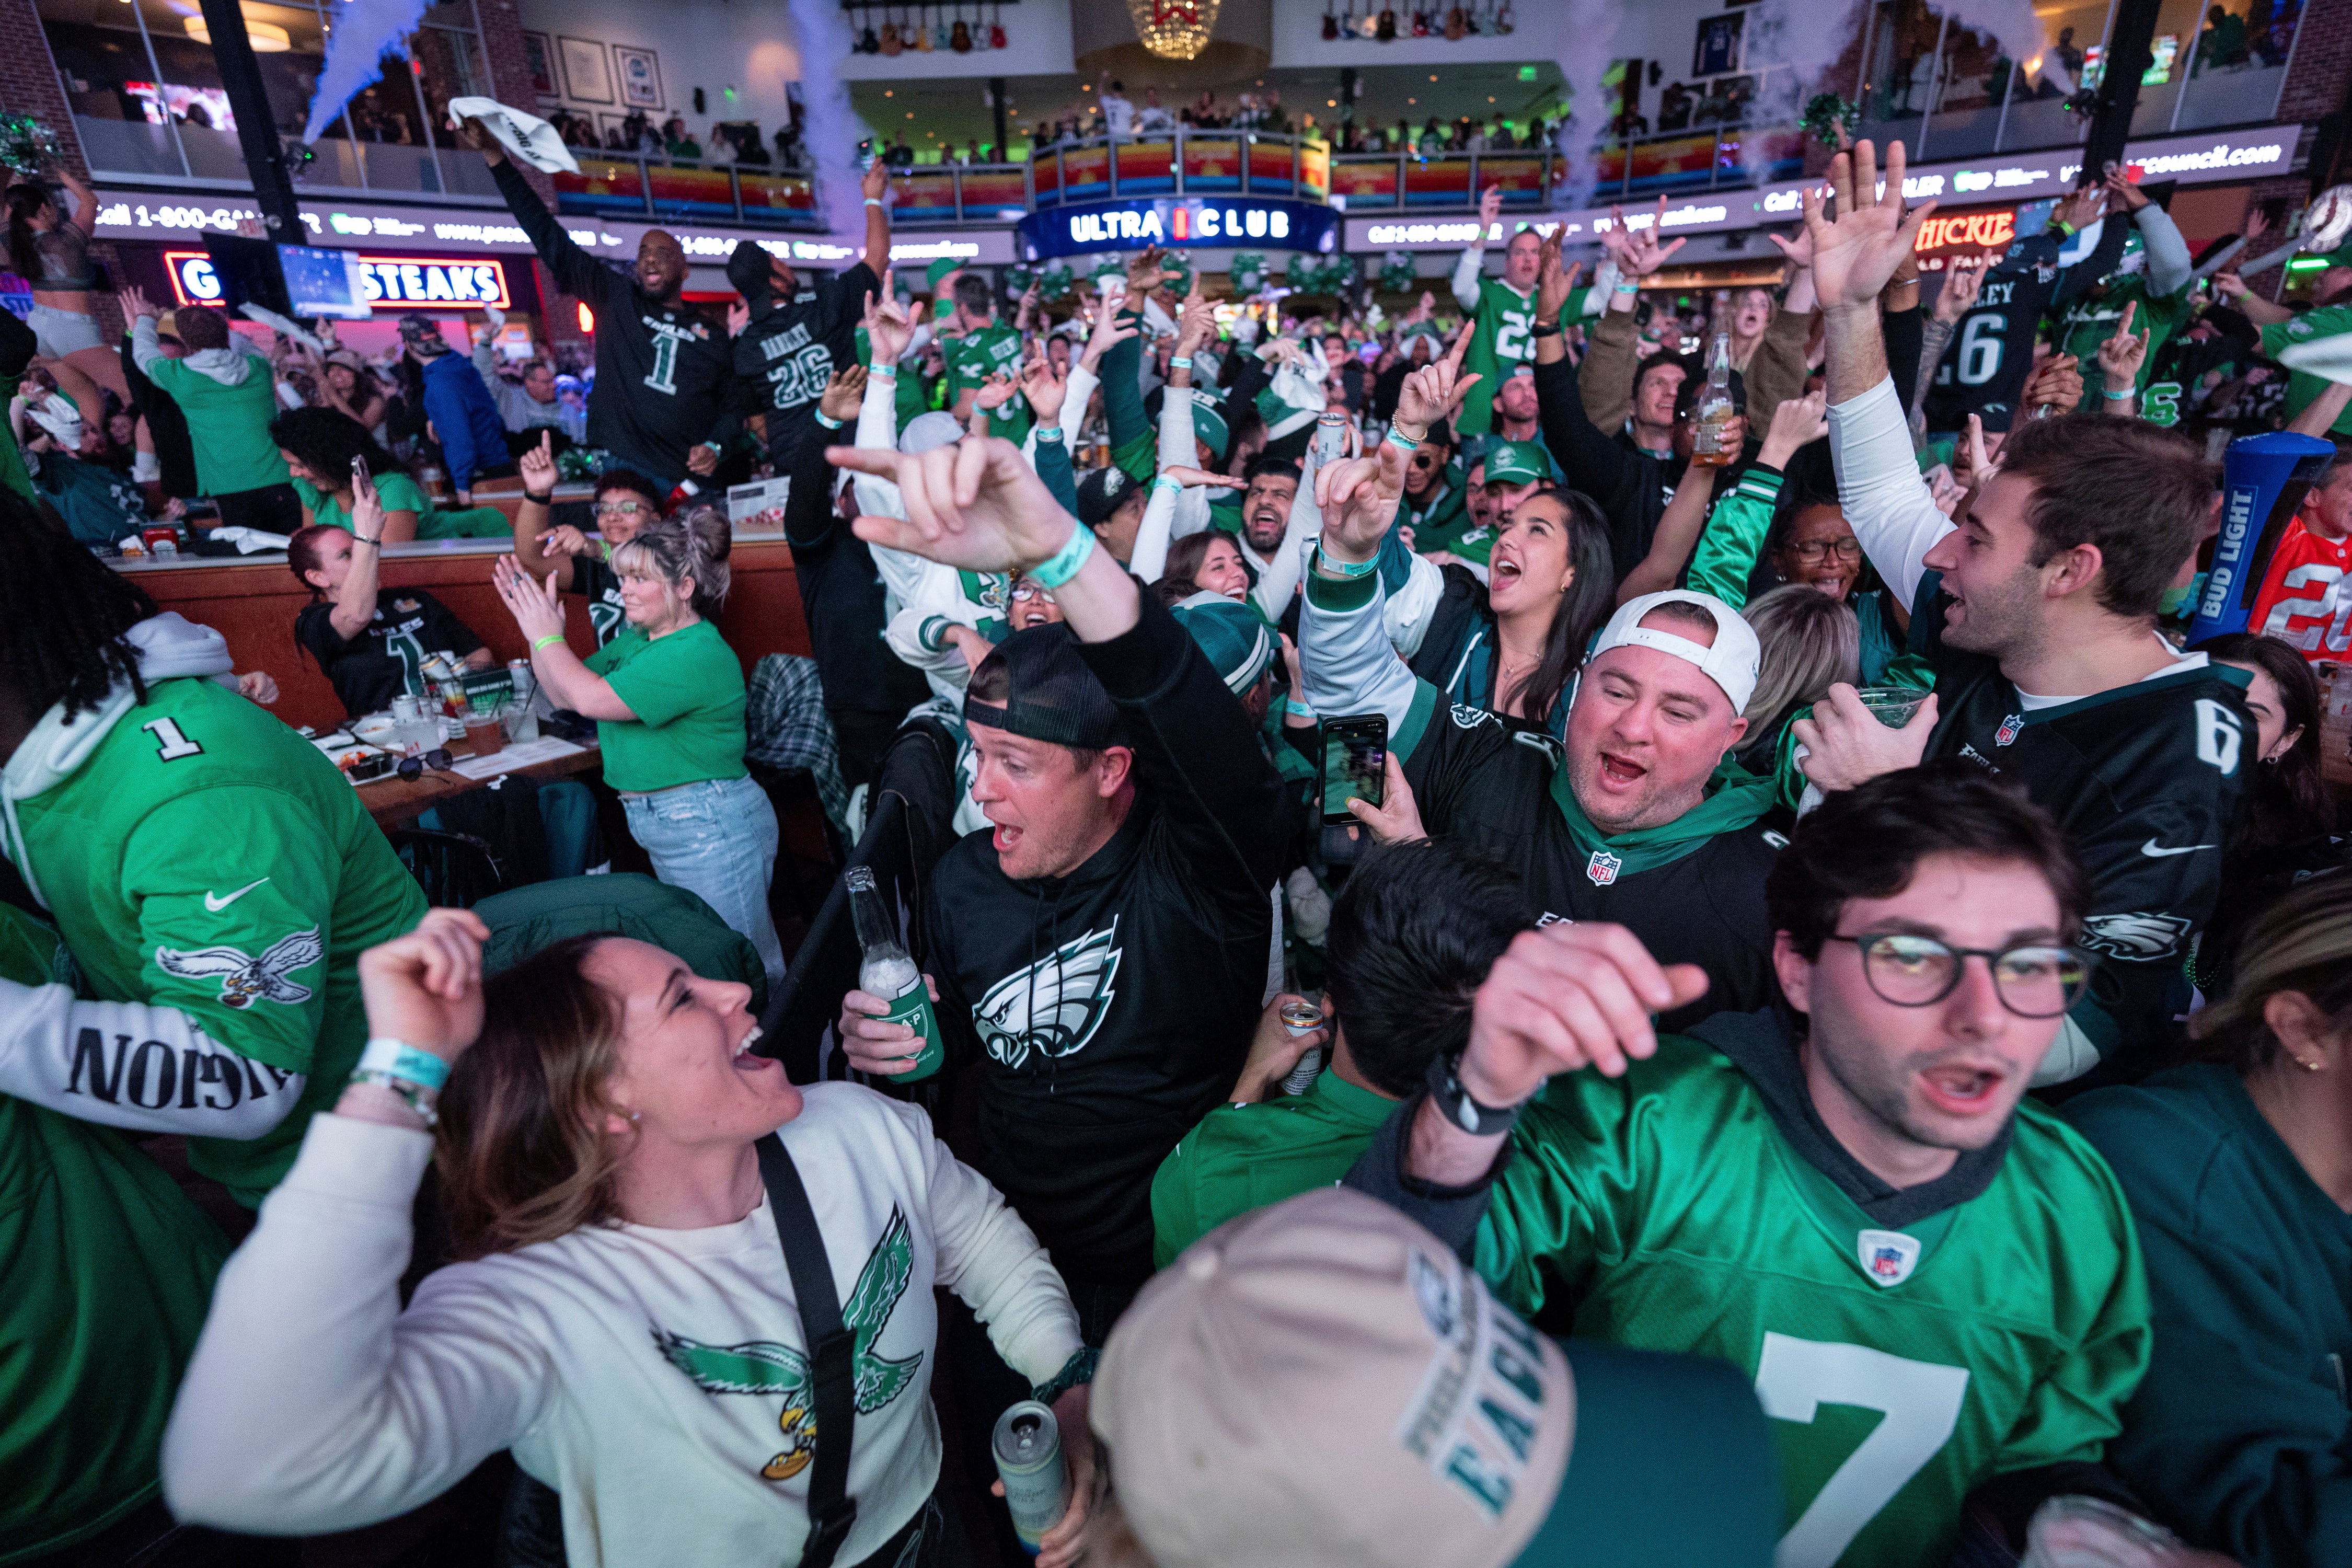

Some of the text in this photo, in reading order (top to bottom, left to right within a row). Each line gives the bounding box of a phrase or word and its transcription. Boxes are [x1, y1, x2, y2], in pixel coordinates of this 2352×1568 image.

[1071, 209, 1289, 242] ULTRA CLUB
[1915, 212, 2016, 252] HICKIE
[359, 263, 501, 302] STEAKS
[1495, 309, 1537, 360] 2
[643, 331, 679, 395] 1
[766, 343, 834, 409] 26
[2200, 490, 2253, 618] BUD LIGHT
[142, 717, 204, 763] 1
[2195, 698, 2242, 775] 6
[1591, 864, 1610, 881] NFL
[1755, 1331, 1970, 1568] 7
